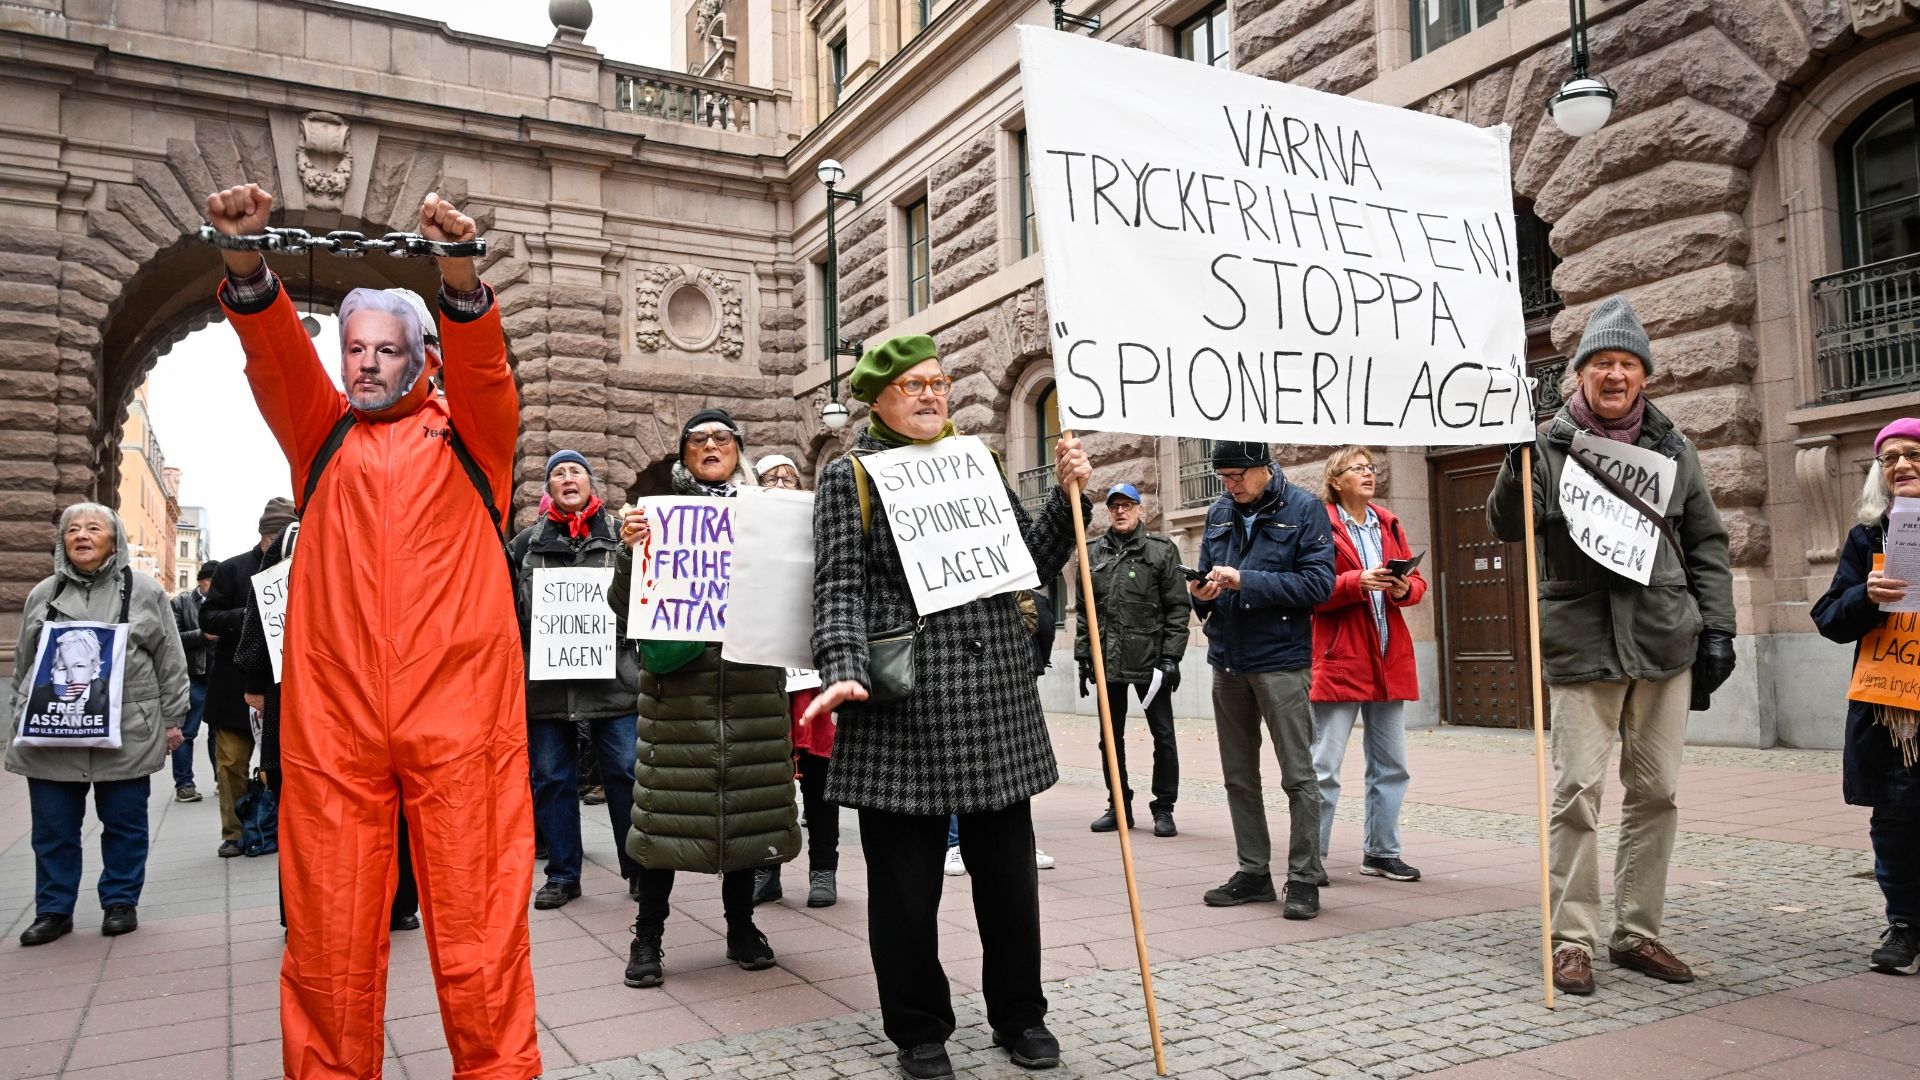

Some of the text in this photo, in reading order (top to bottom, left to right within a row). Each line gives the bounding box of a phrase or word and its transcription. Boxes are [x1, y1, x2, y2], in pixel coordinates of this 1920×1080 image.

[1223, 104, 1382, 190] VÄRNA
[1047, 150, 1513, 283] TRYCKFRIHETEN!
[1203, 254, 1466, 349] STOPPA
[880, 453, 984, 491] STOPPA
[889, 495, 1011, 541] "SPIONERI-
[654, 548, 732, 580] FRIHE
[918, 534, 1010, 592] LAGEN"
[543, 582, 604, 603] STOPPA
[690, 580, 730, 600] UN
[534, 614, 615, 635] "SPIONERI-
[548, 645, 612, 667] LAGEN"
[1872, 636, 1920, 666] LAG
[30, 713, 104, 726] ASSANGE
[47, 702, 86, 714] FREE
